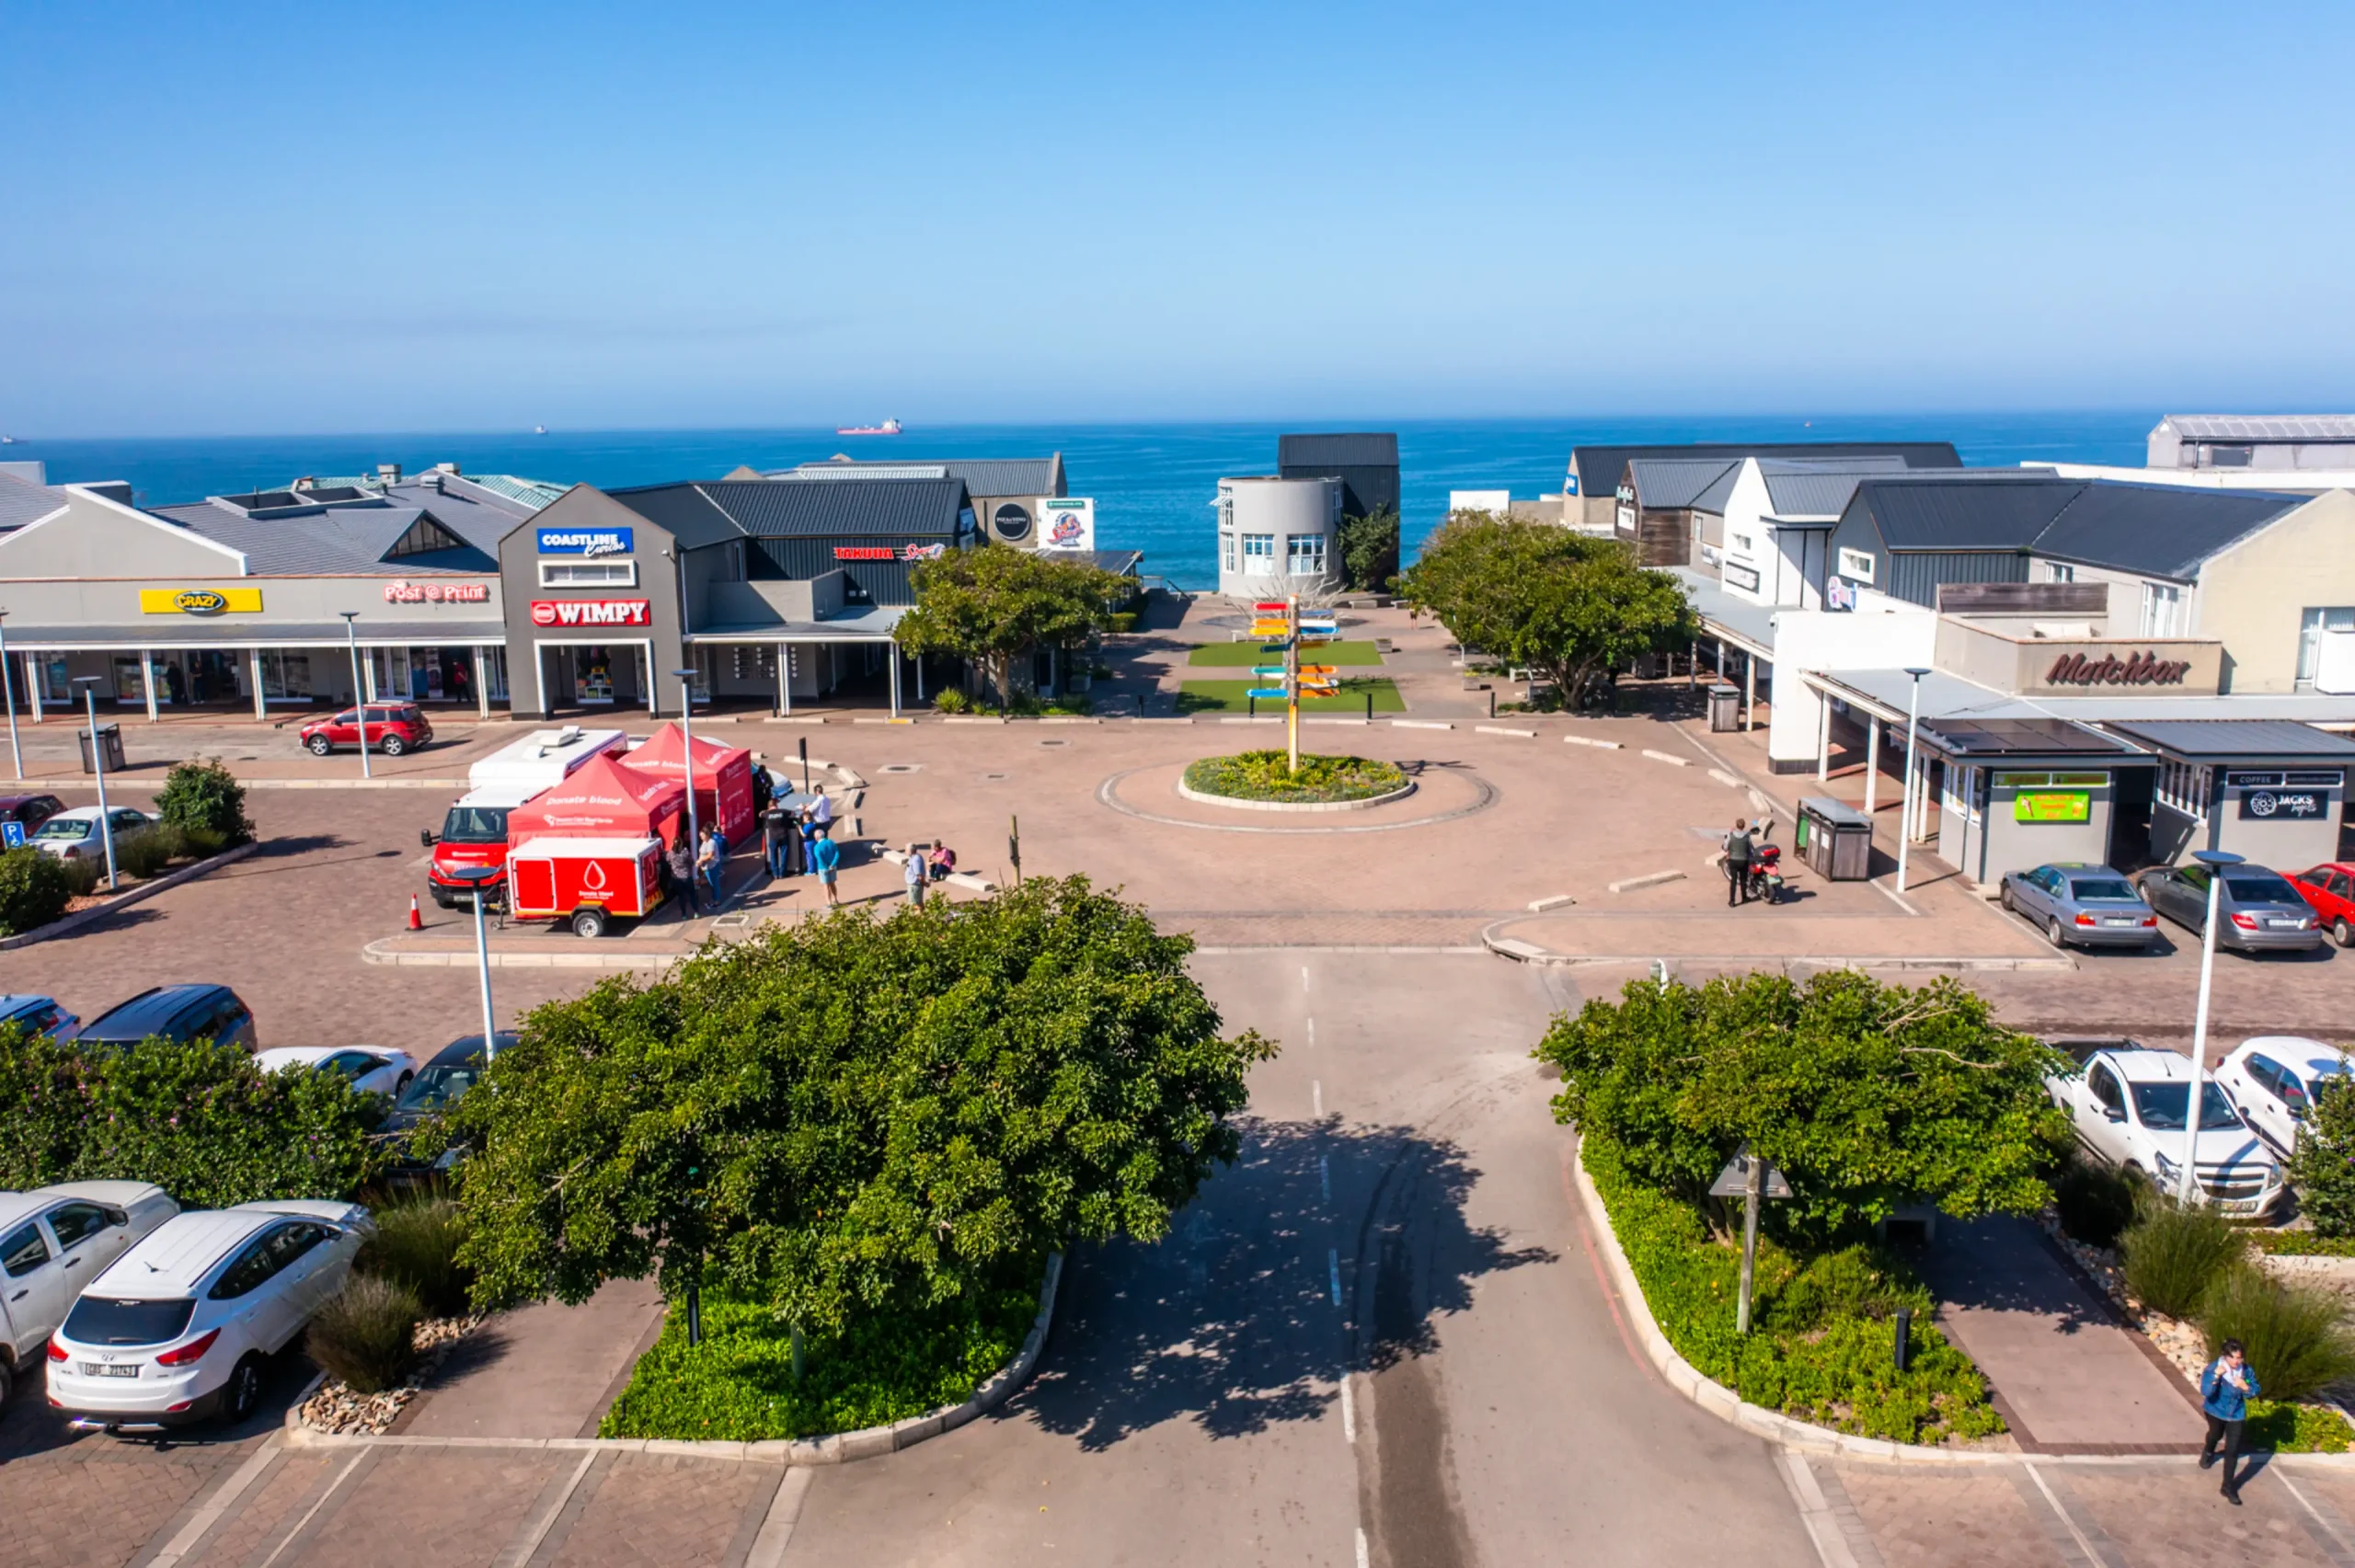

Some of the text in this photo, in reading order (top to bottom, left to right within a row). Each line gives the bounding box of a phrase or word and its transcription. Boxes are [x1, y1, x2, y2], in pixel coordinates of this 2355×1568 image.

[542, 534, 617, 545] COASTLINE
[584, 542, 626, 556] Curios
[384, 585, 486, 601] Post @ Print
[178, 595, 218, 607] CRAZY
[556, 602, 646, 624] WIMPY
[2046, 651, 2191, 686] Matchbox
[546, 795, 623, 806] Donate blood
[2278, 795, 2314, 805] JACKS
[7, 825, 17, 836] P
